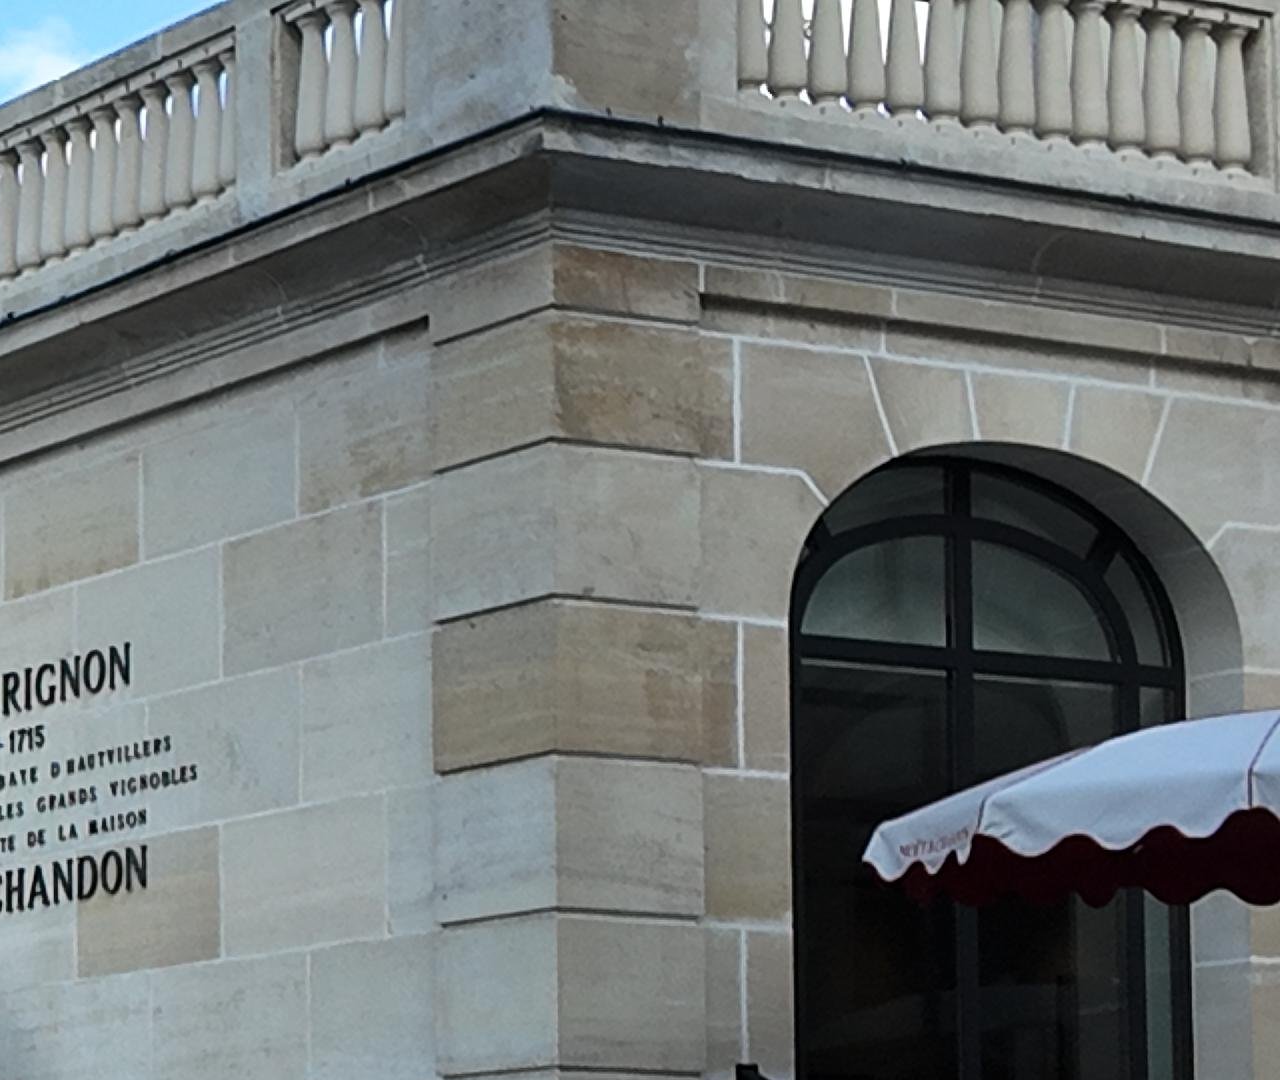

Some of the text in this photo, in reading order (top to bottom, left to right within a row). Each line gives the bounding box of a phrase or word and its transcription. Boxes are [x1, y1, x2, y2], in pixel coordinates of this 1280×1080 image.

[8, 724, 46, 755] 1715
[49, 734, 172, 780] DHAUTVILLERS
[36, 785, 98, 814] GRANDS
[109, 763, 198, 798] VIGNOBLES
[26, 828, 47, 849] DE
[57, 823, 79, 843] LA
[87, 808, 147, 837] MAISON
